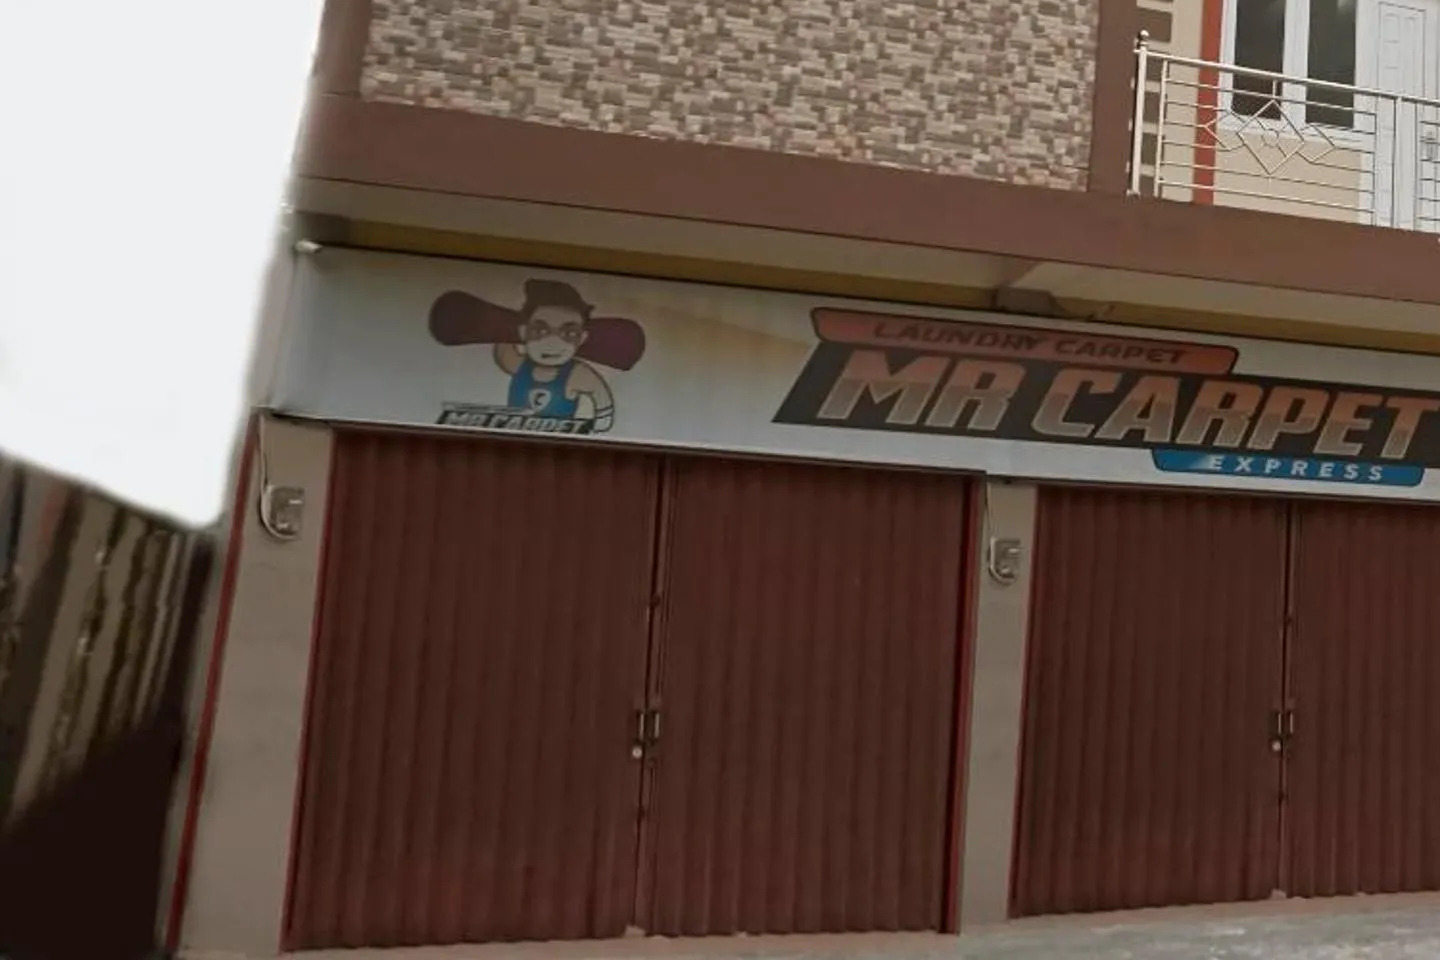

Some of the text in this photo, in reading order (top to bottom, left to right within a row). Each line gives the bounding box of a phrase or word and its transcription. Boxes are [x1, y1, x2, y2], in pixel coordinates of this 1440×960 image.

[873, 321, 1188, 364] LAUNDRY CARPET
[816, 348, 1027, 431] MR
[1208, 452, 1385, 482] EXPRESS
